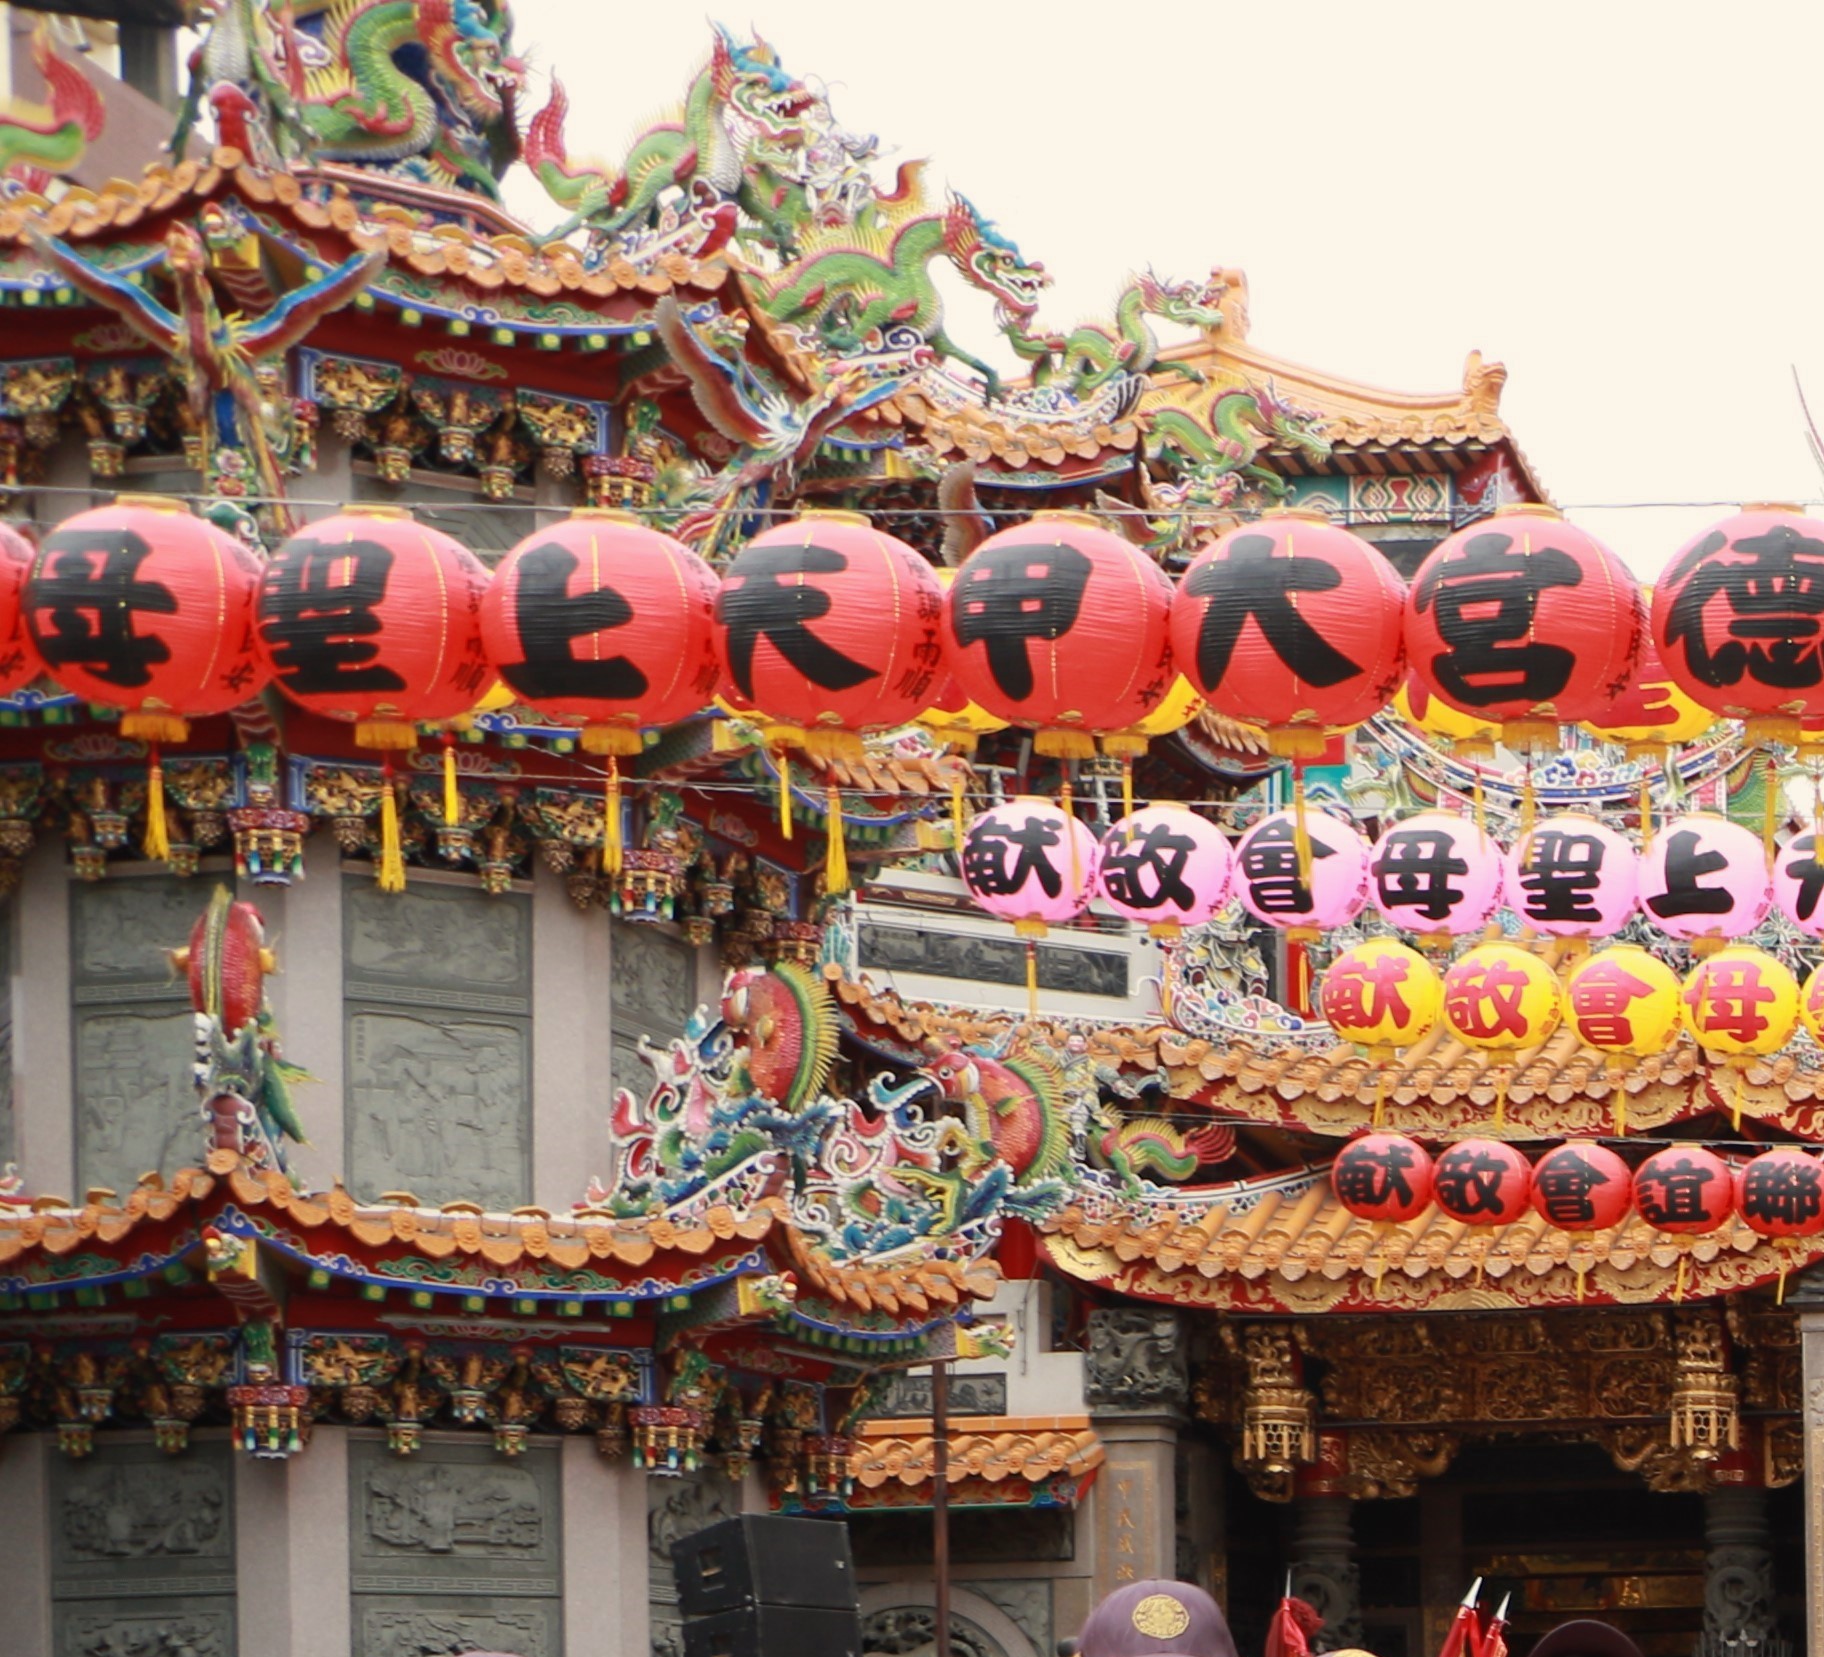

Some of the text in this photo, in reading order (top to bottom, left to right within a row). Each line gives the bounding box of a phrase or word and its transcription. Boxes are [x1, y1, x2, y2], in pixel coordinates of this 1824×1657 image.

[22, 530, 178, 686] 母
[257, 538, 407, 692] 聖
[499, 541, 649, 698] 上
[715, 543, 880, 700] 天
[951, 542, 1093, 700] 甲
[1186, 535, 1365, 689] 大
[1416, 532, 1583, 699] 宮
[1102, 822, 1197, 910] 敬
[1242, 820, 1337, 913] 會
[1372, 830, 1468, 920] 母
[1522, 830, 1607, 922] 聖
[1646, 831, 1734, 917] 上
